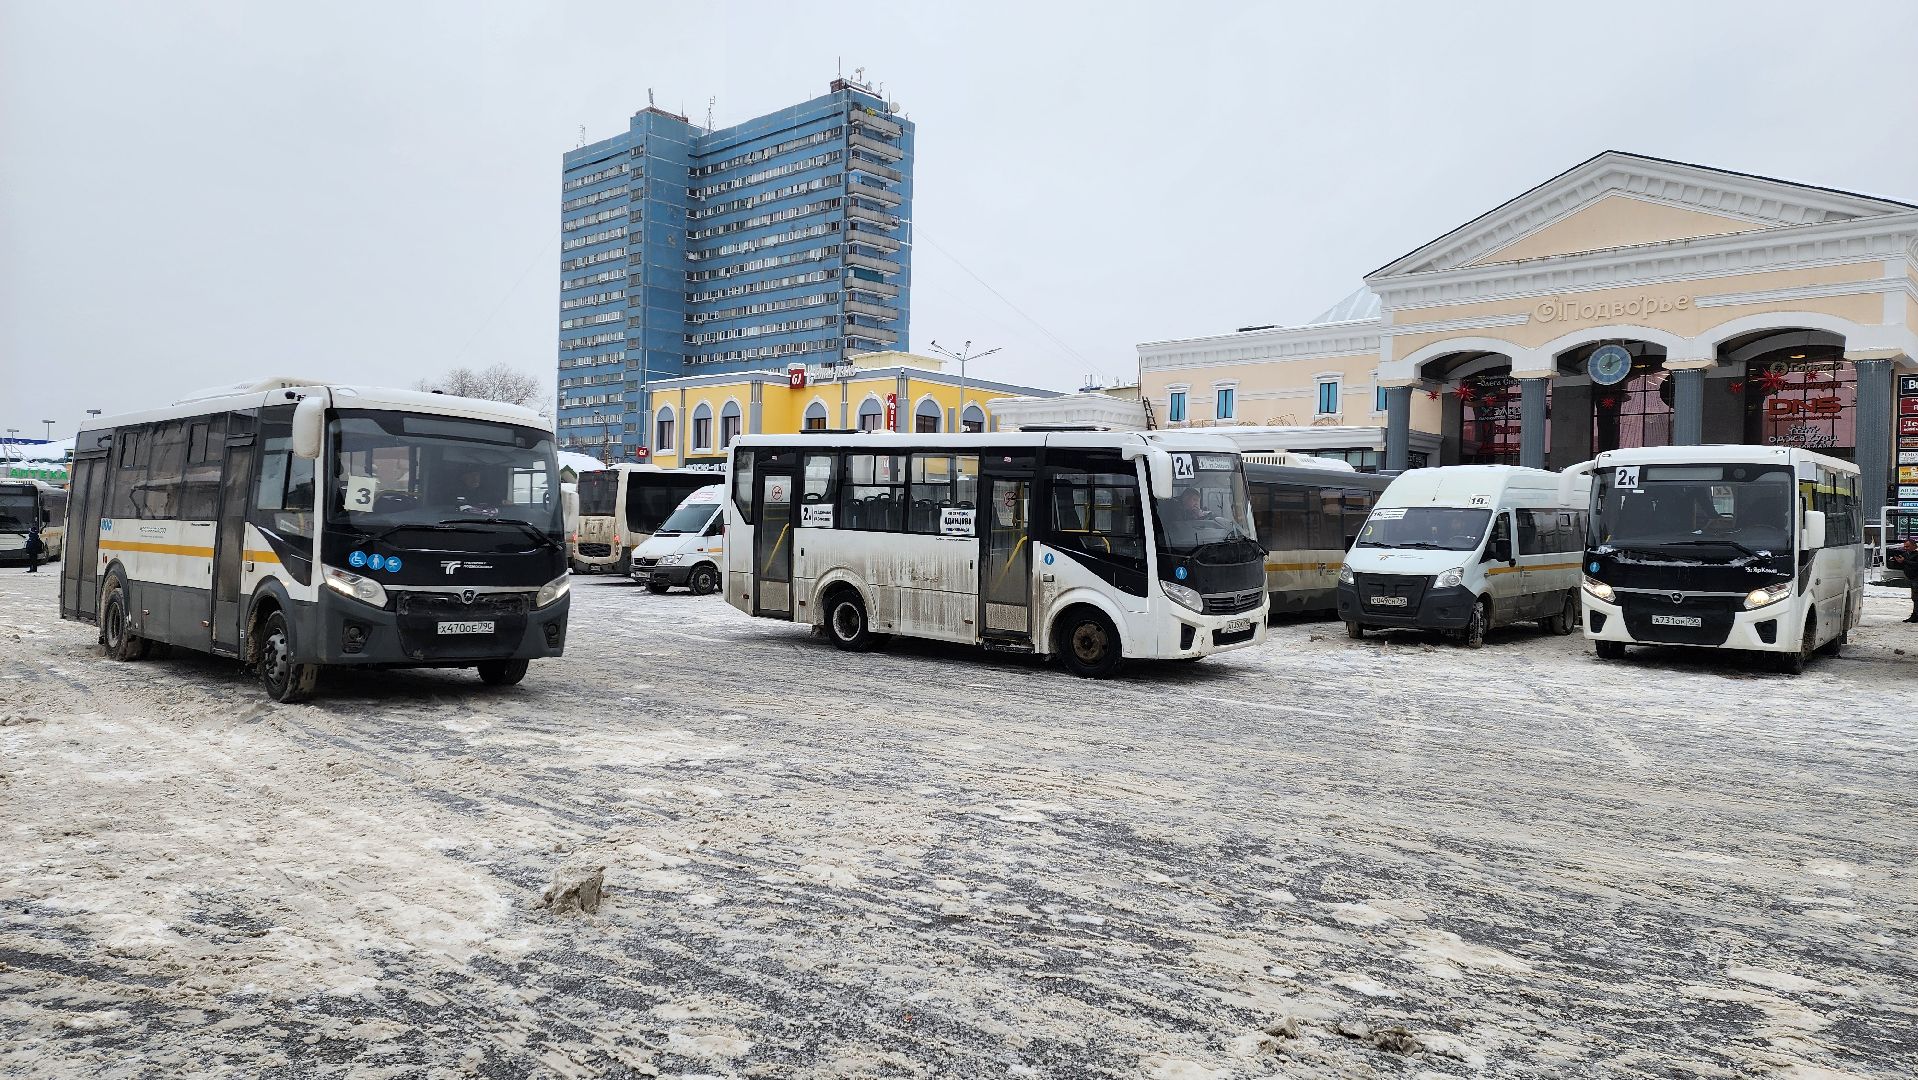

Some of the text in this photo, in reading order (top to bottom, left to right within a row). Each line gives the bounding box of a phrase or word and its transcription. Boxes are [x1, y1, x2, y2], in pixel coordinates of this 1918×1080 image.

[1768, 397, 1842, 415] DNS
[10, 467, 68, 480] АПТЕКА
[355, 487, 371, 505] 3
